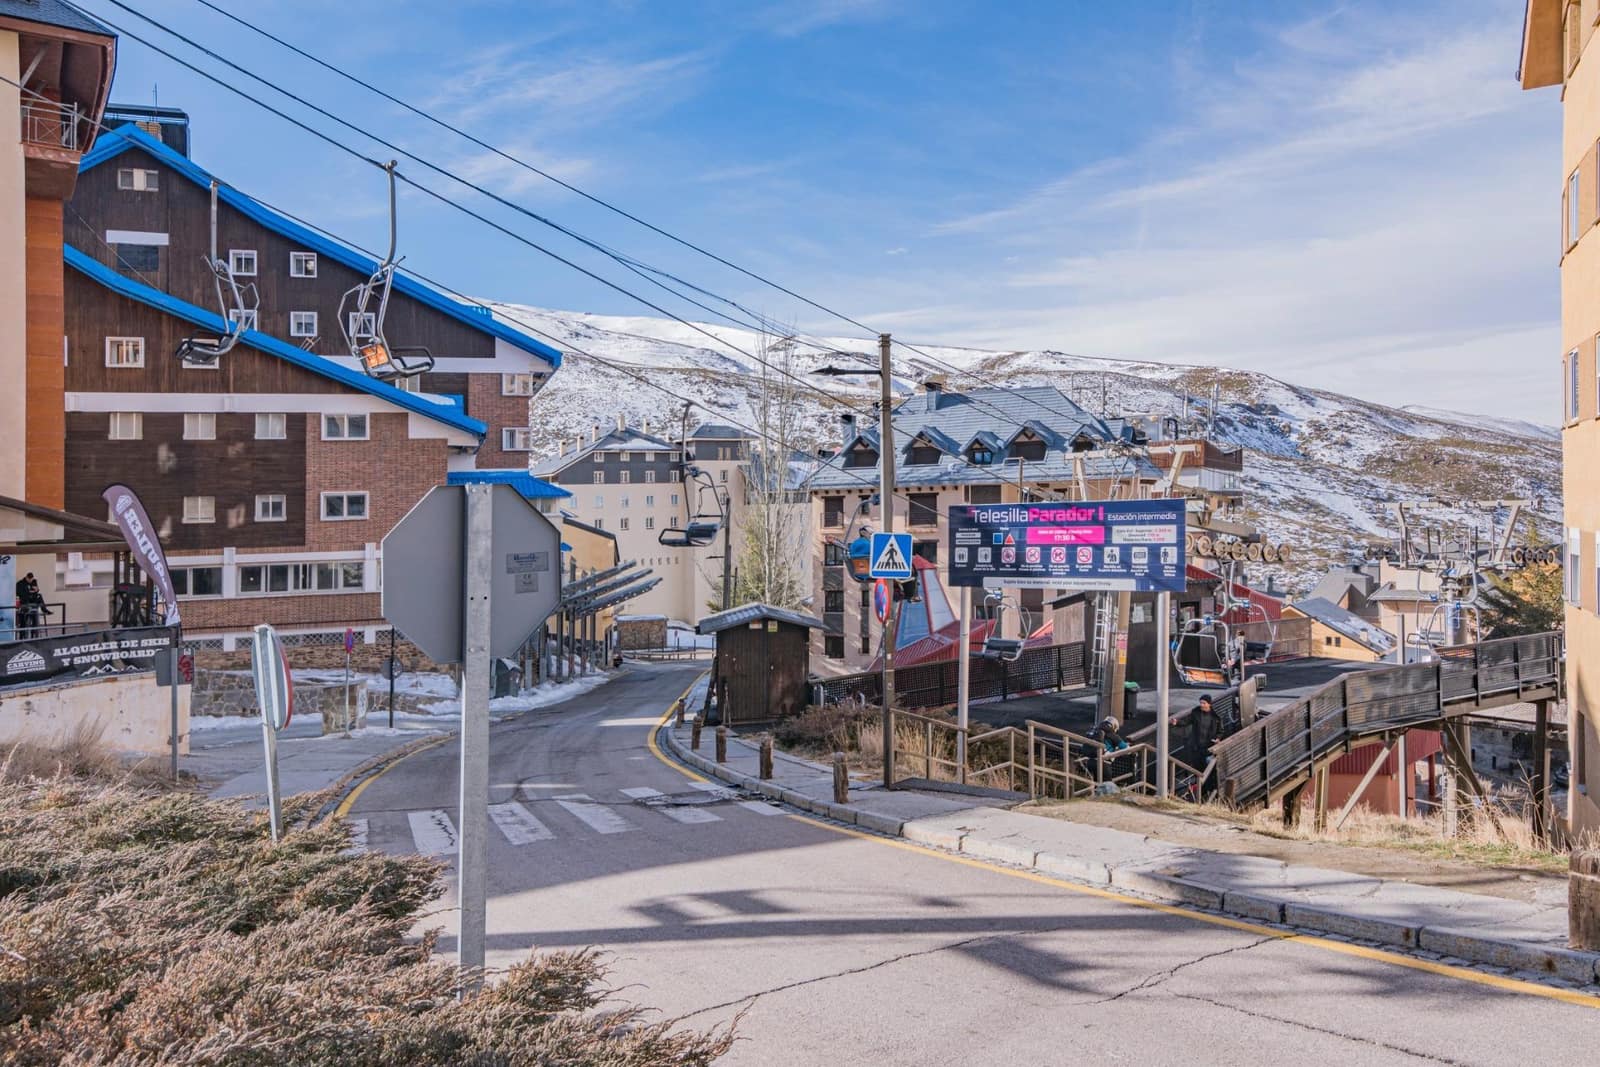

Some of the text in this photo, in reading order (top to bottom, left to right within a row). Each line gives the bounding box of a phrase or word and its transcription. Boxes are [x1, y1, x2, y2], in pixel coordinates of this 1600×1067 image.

[1107, 512, 1177, 521] Estación intermedia
[53, 637, 170, 657] ALQUILER DE SKIS
[7, 659, 46, 669] CARVING
[61, 648, 163, 666] Y SNOWBOARD
